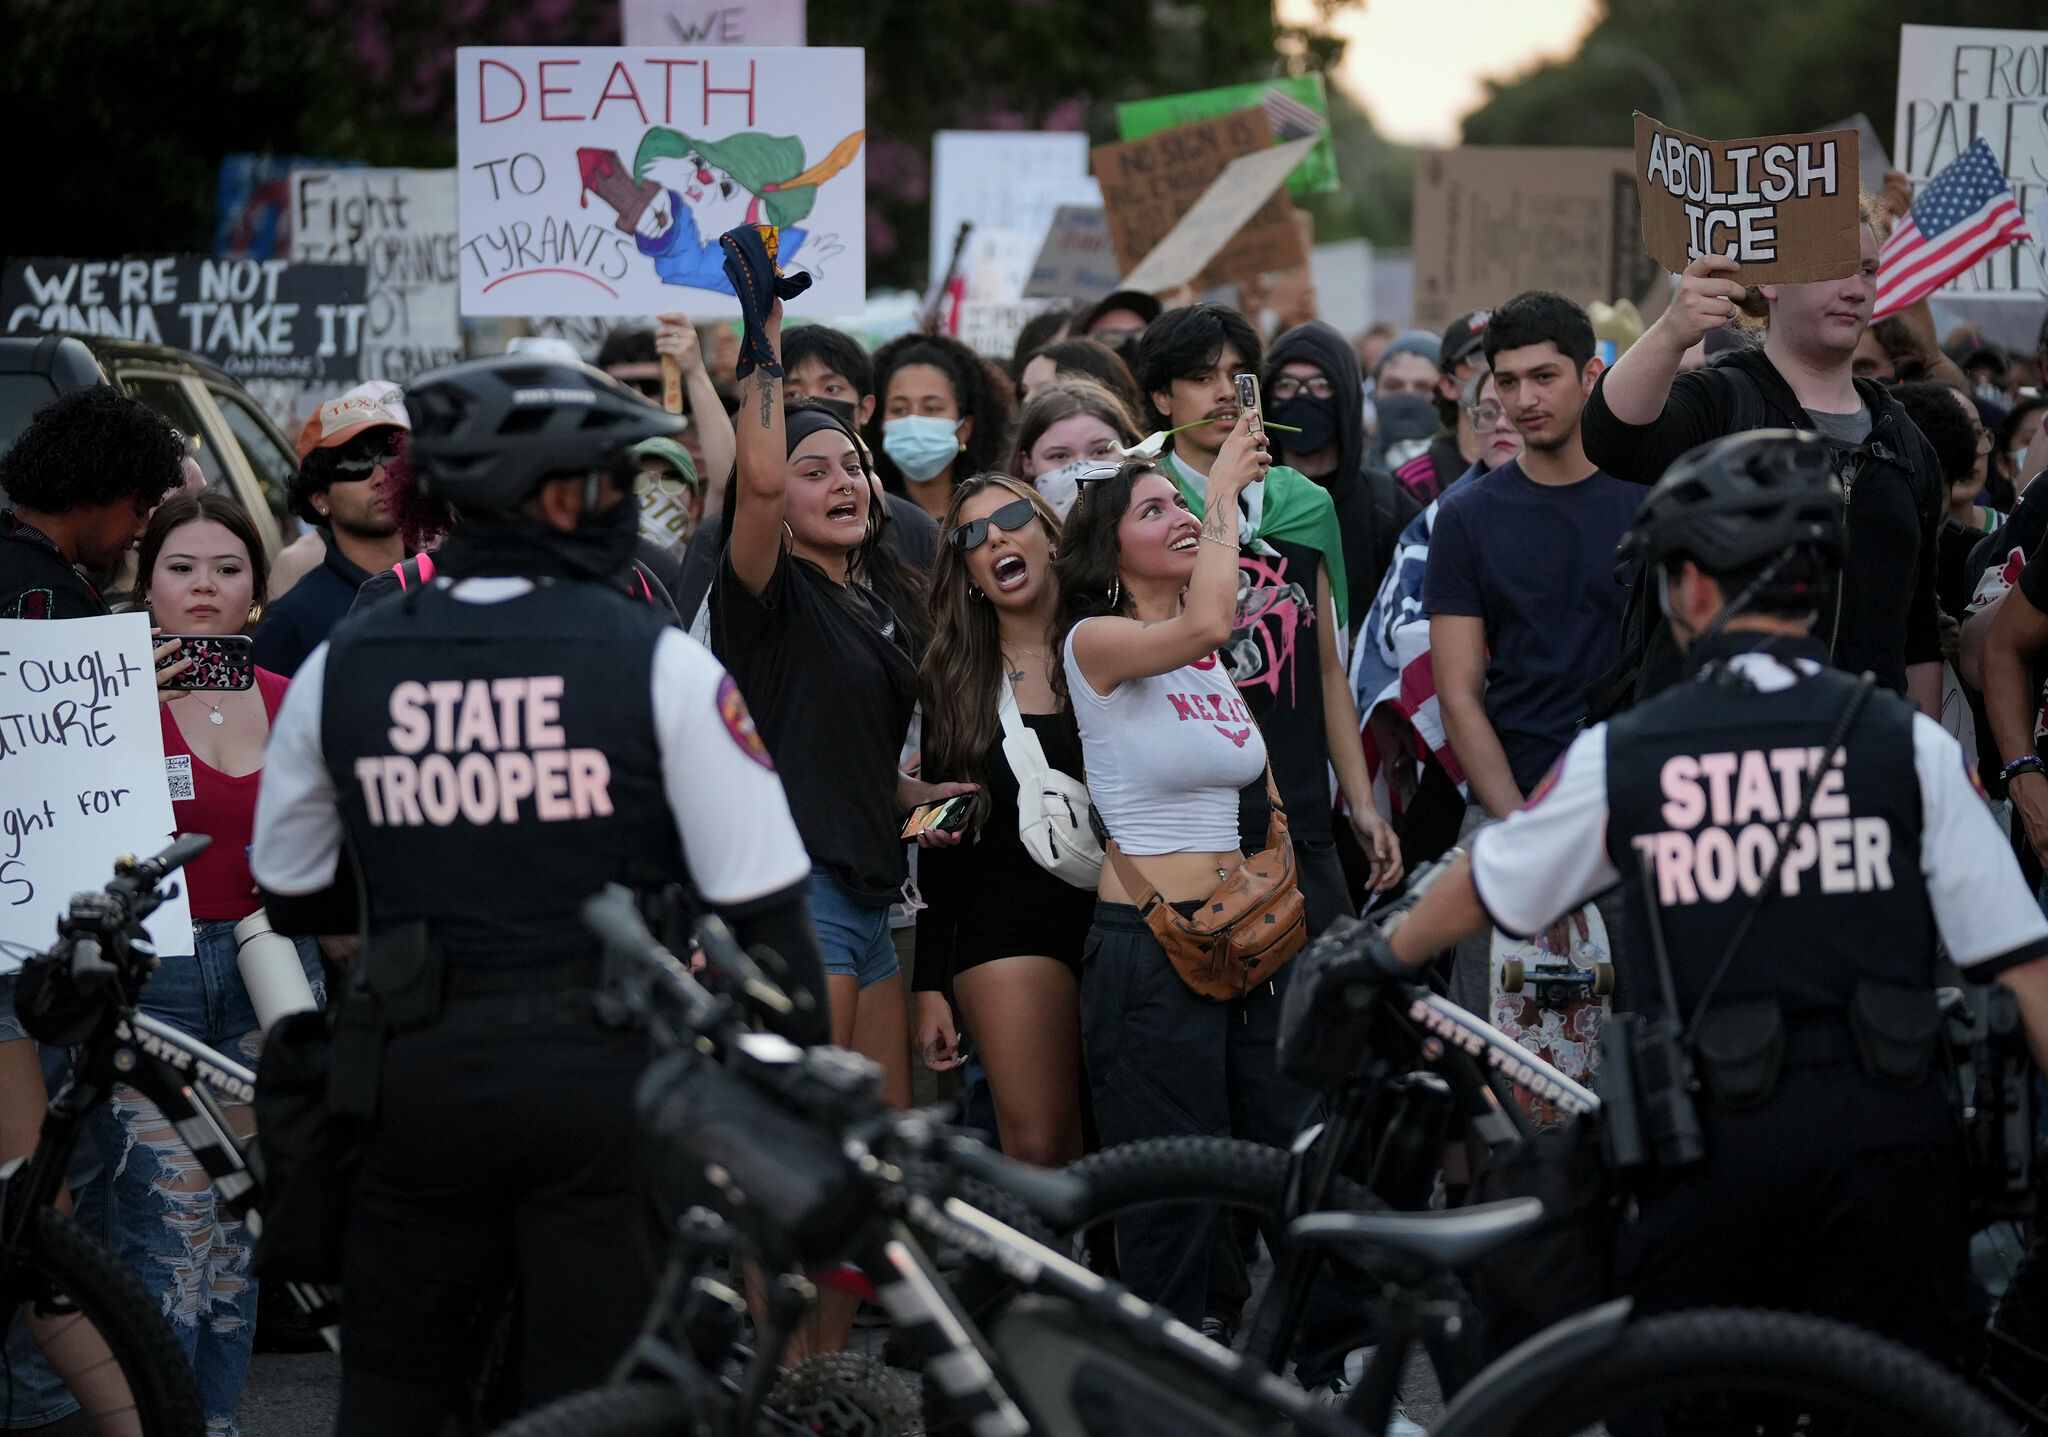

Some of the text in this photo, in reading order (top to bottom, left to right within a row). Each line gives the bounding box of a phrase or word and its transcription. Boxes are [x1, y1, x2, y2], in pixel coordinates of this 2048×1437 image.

[666, 7, 746, 42] WE
[479, 58, 756, 126] DEATH
[473, 152, 545, 200] TO
[1647, 131, 1839, 206] ABOLISH
[299, 175, 408, 244] Fight
[1684, 202, 1778, 265] ICE
[23, 257, 289, 305] WE'RE NOT
[461, 215, 634, 281] TYRANTS
[179, 302, 300, 355] TAKE
[315, 303, 367, 357] IT
[387, 675, 566, 755] STATE
[1166, 693, 1252, 723] MEXIC
[353, 747, 615, 828] TROOPER
[1659, 745, 1850, 830] STATE
[1631, 815, 1895, 907] TROOPER
[1408, 999, 1486, 1057] STATE
[114, 1019, 256, 1105] STATE TROO
